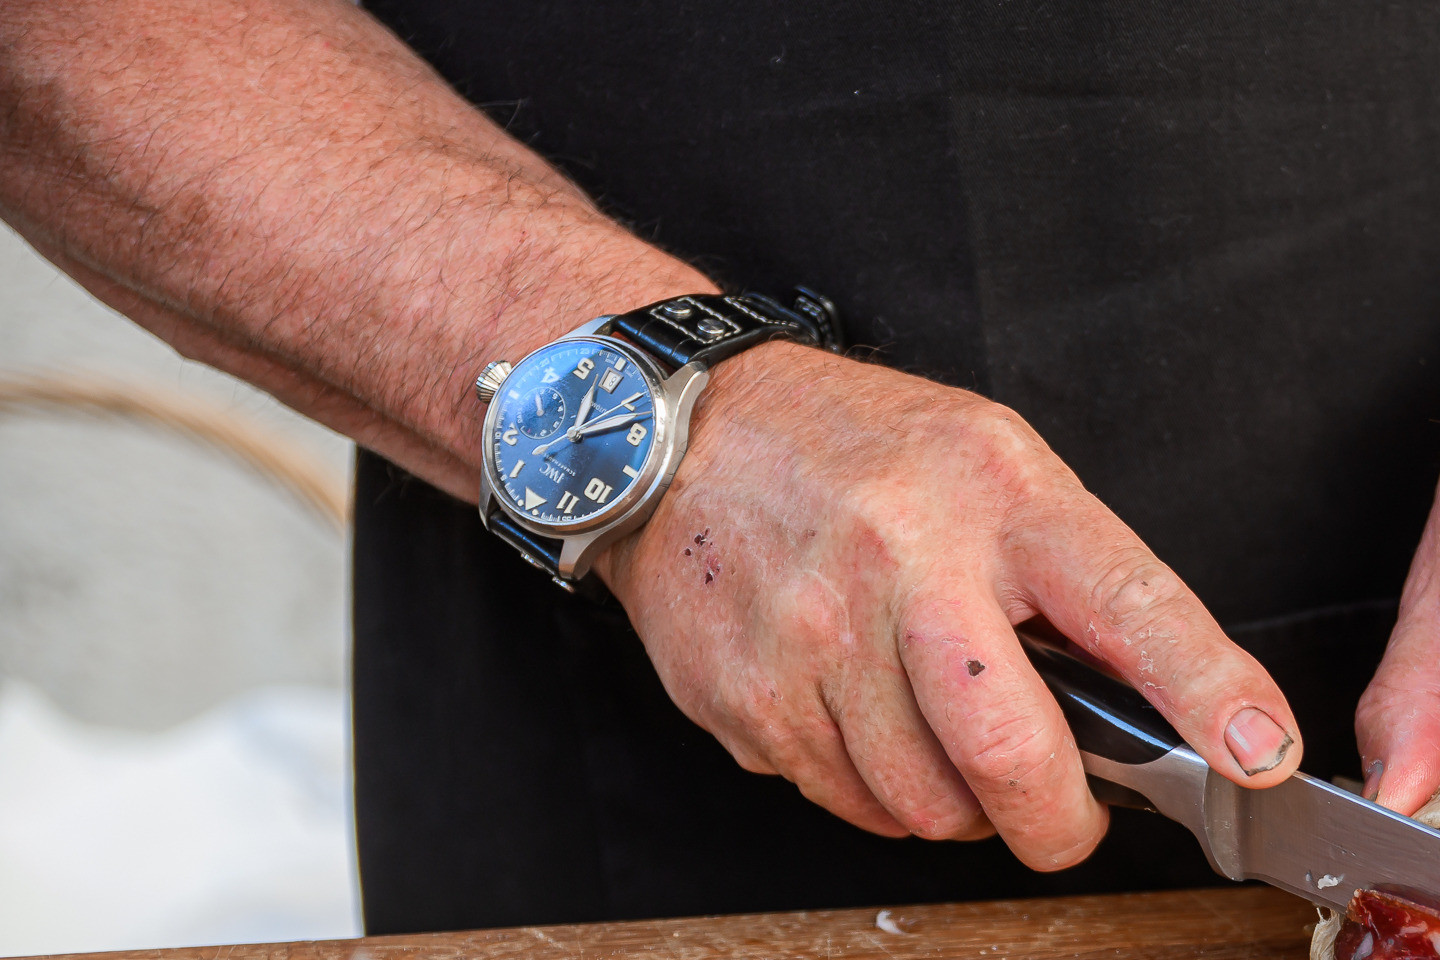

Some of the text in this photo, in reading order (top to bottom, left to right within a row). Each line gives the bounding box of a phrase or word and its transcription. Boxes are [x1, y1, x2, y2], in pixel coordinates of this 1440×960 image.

[541, 367, 561, 384] 4
[573, 357, 595, 380] 5
[502, 422, 519, 446] 2
[626, 422, 648, 447] 8
[509, 459, 526, 478] 1
[538, 462, 566, 484] IWC
[556, 490, 580, 514] 11
[583, 477, 614, 504] 10
